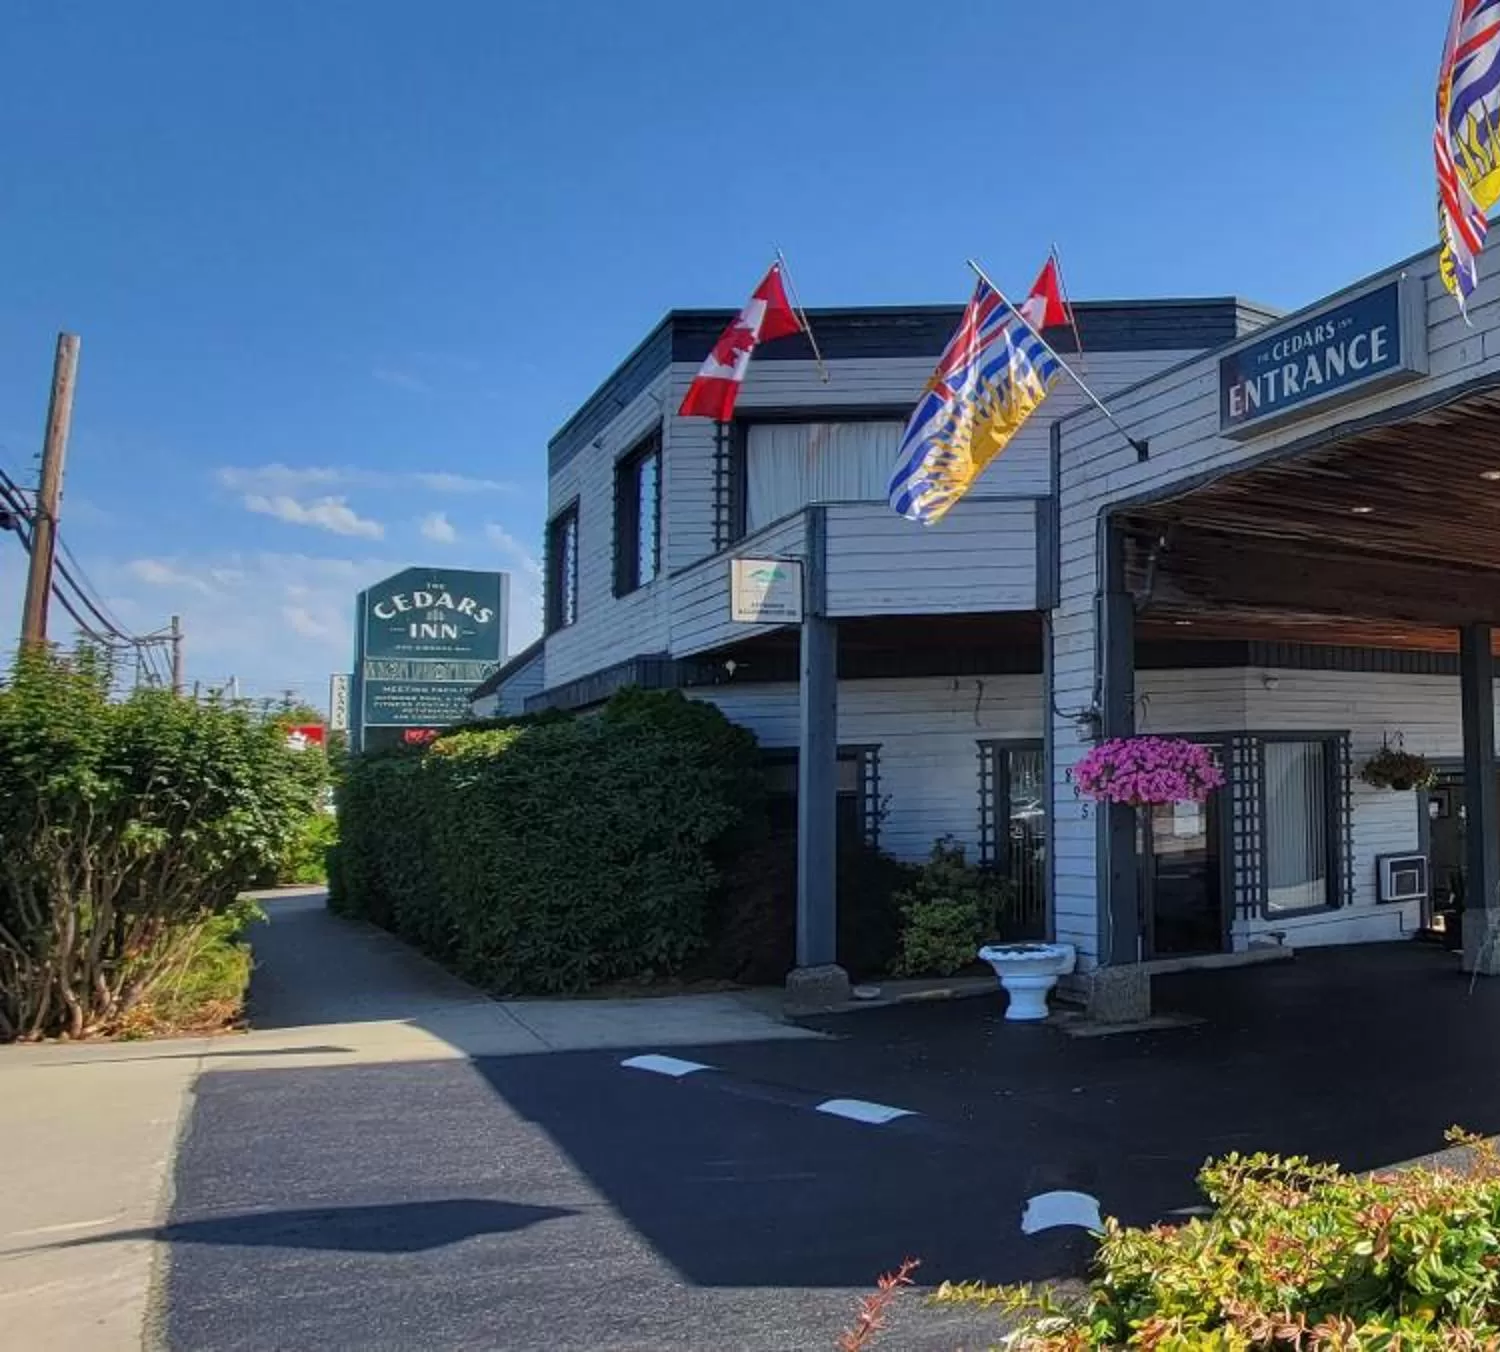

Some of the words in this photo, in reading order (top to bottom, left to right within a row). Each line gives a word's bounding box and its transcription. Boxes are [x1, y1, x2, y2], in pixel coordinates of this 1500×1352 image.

[1272, 320, 1335, 361] CEDARS
[1228, 325, 1389, 417] ENTRANCE
[373, 591, 494, 624] CEDARS
[409, 623, 458, 639] INN
[383, 685, 429, 693] MEETING
